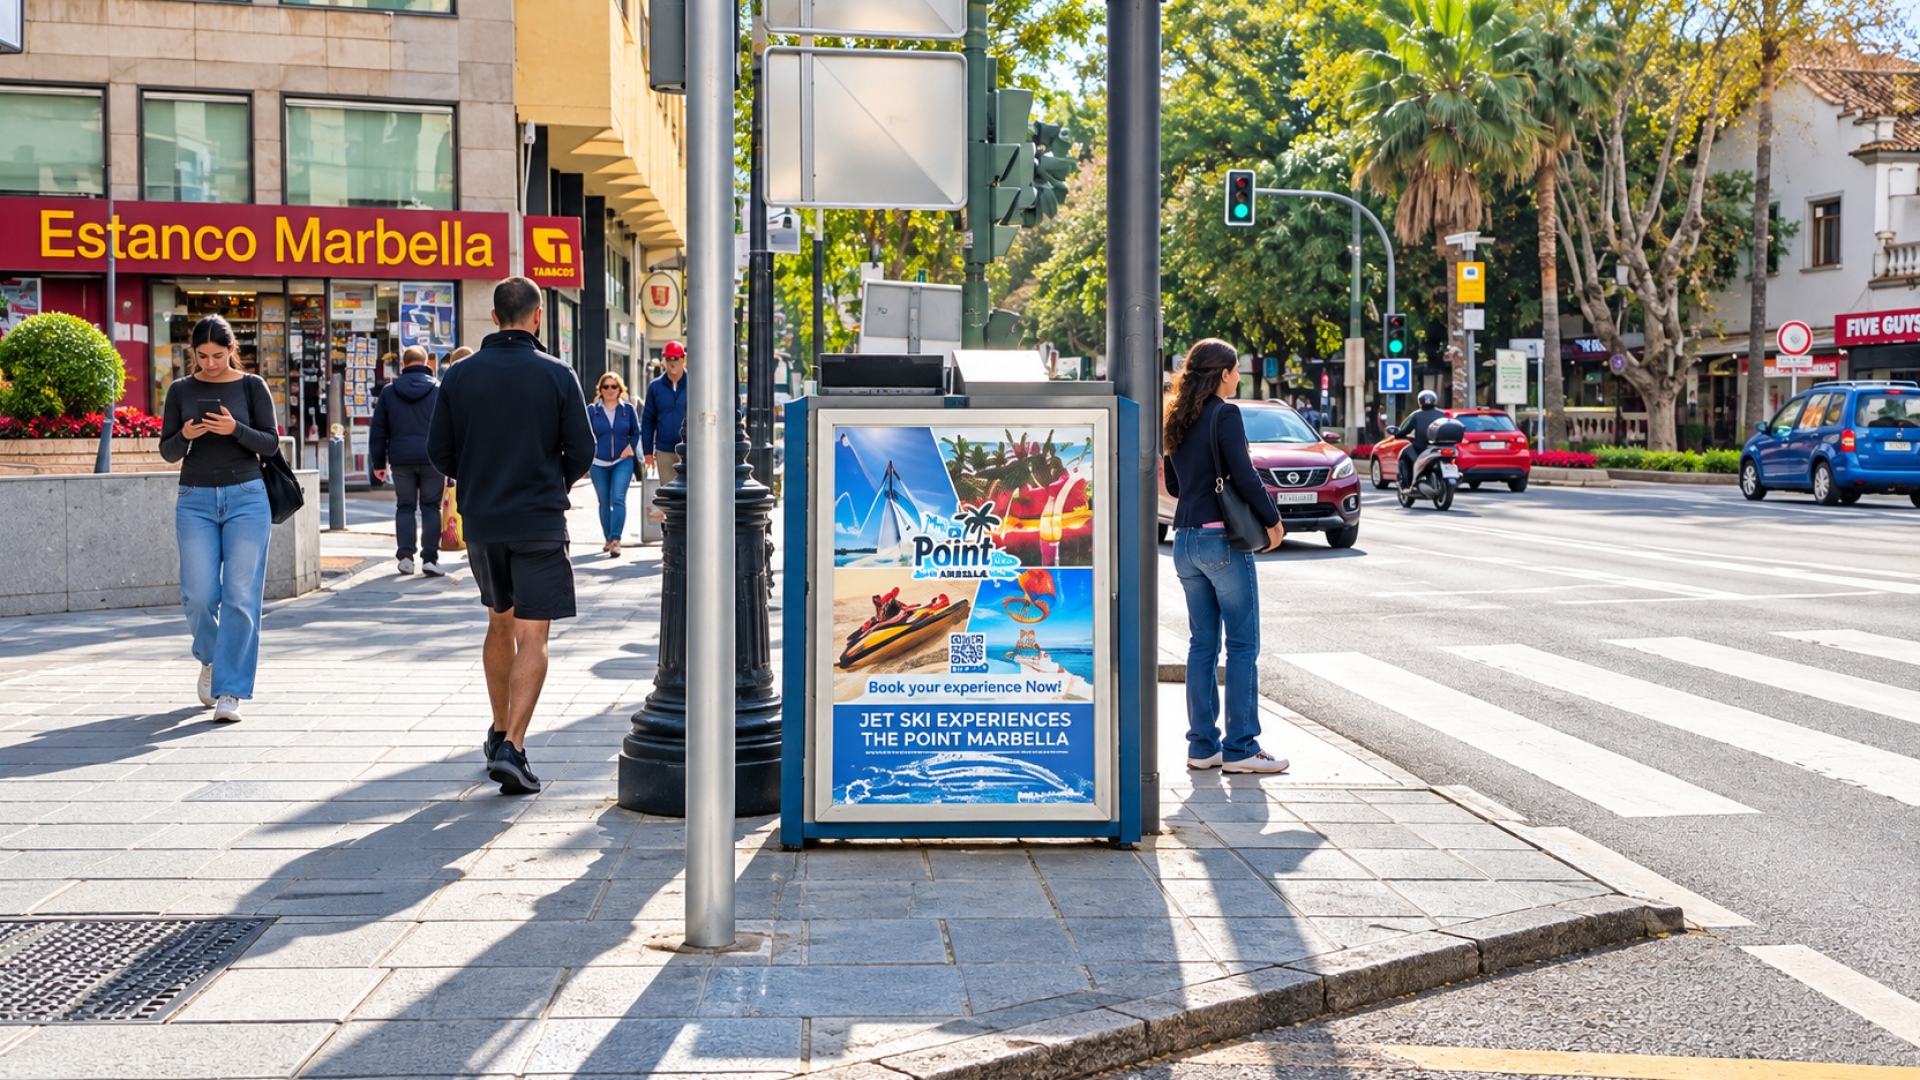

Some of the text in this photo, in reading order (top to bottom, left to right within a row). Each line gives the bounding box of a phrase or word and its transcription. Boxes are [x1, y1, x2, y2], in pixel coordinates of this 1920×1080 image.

[40, 209, 494, 267] Estanco Marbella
[1846, 313, 1920, 338] FIVE GUYS
[1386, 363, 1405, 388] P
[912, 536, 993, 567] Point
[868, 680, 1062, 697] Book your experience Now!
[859, 712, 1072, 728] JET SKI EXPERIENCES
[861, 731, 1070, 747] THE POINT MARBELLA
